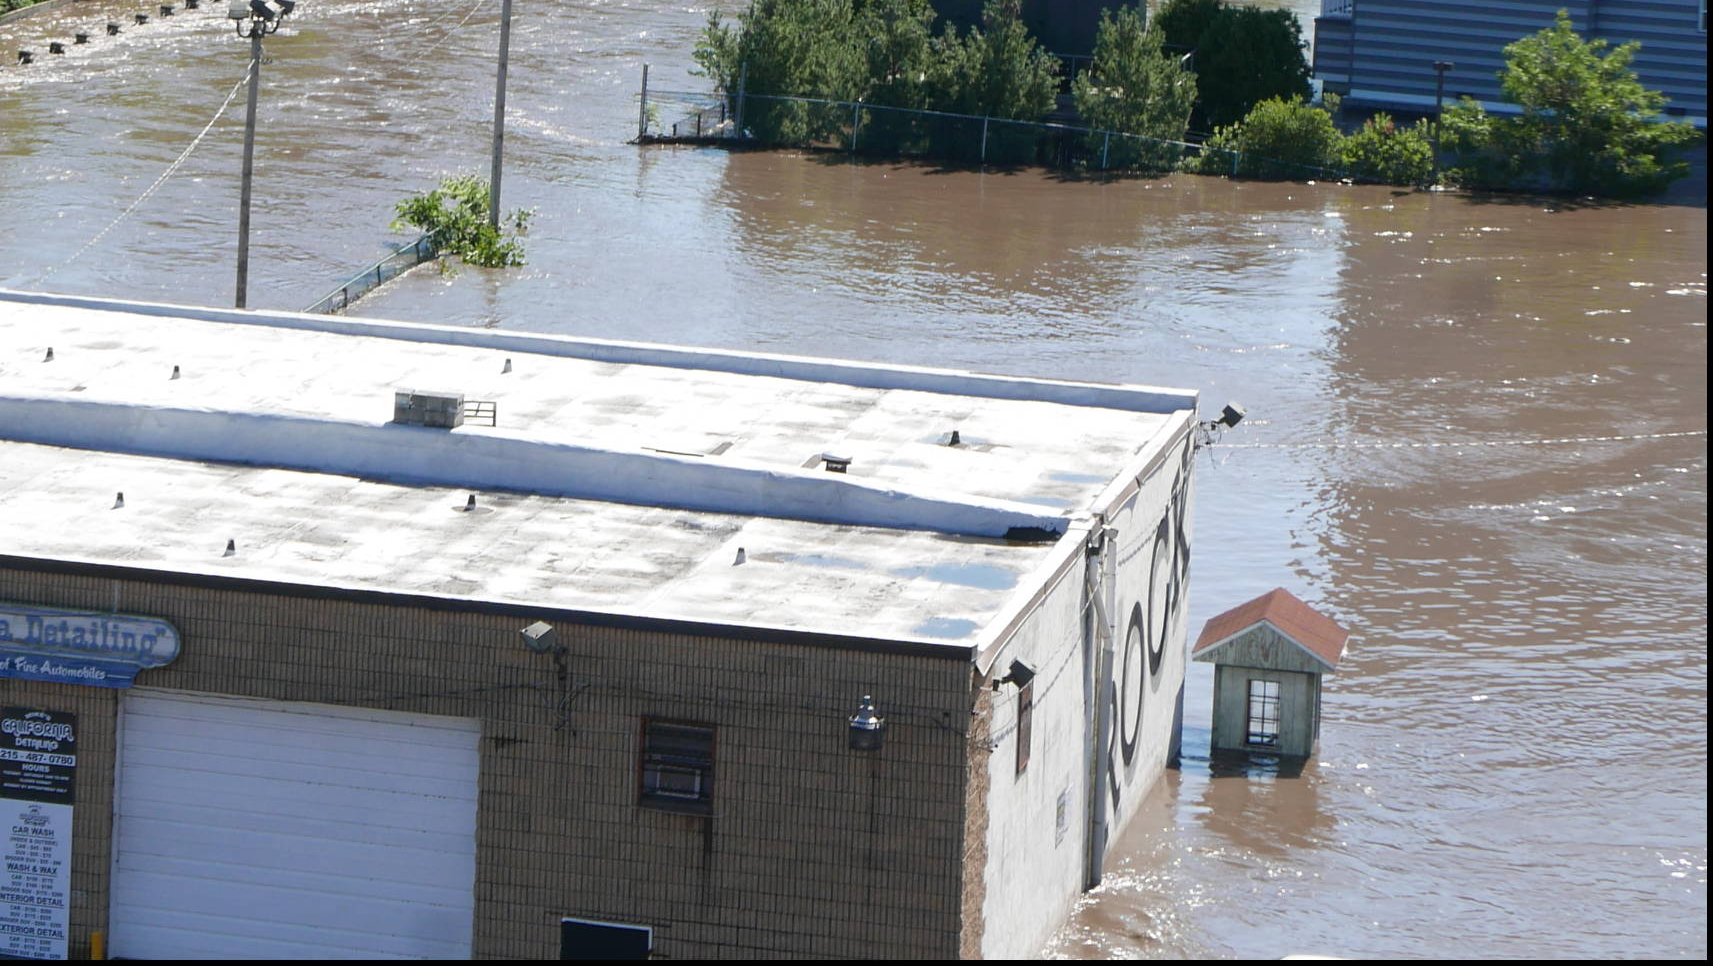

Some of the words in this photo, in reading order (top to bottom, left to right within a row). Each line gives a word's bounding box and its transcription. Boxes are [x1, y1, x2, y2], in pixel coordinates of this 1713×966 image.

[0, 657, 10, 671] of
[15, 657, 38, 674] Fine
[40, 660, 106, 680] Automobiles
[2, 718, 75, 742] CALIFORNIA
[16, 737, 59, 751] DETAILING
[22, 764, 50, 773] HOURS
[13, 826, 29, 834] CAR
[32, 828, 55, 836] WASH
[7, 863, 30, 872] WASH
[40, 866, 58, 874] WAX
[38, 897, 64, 907] DETAIL
[38, 928, 64, 938] DETAIL
